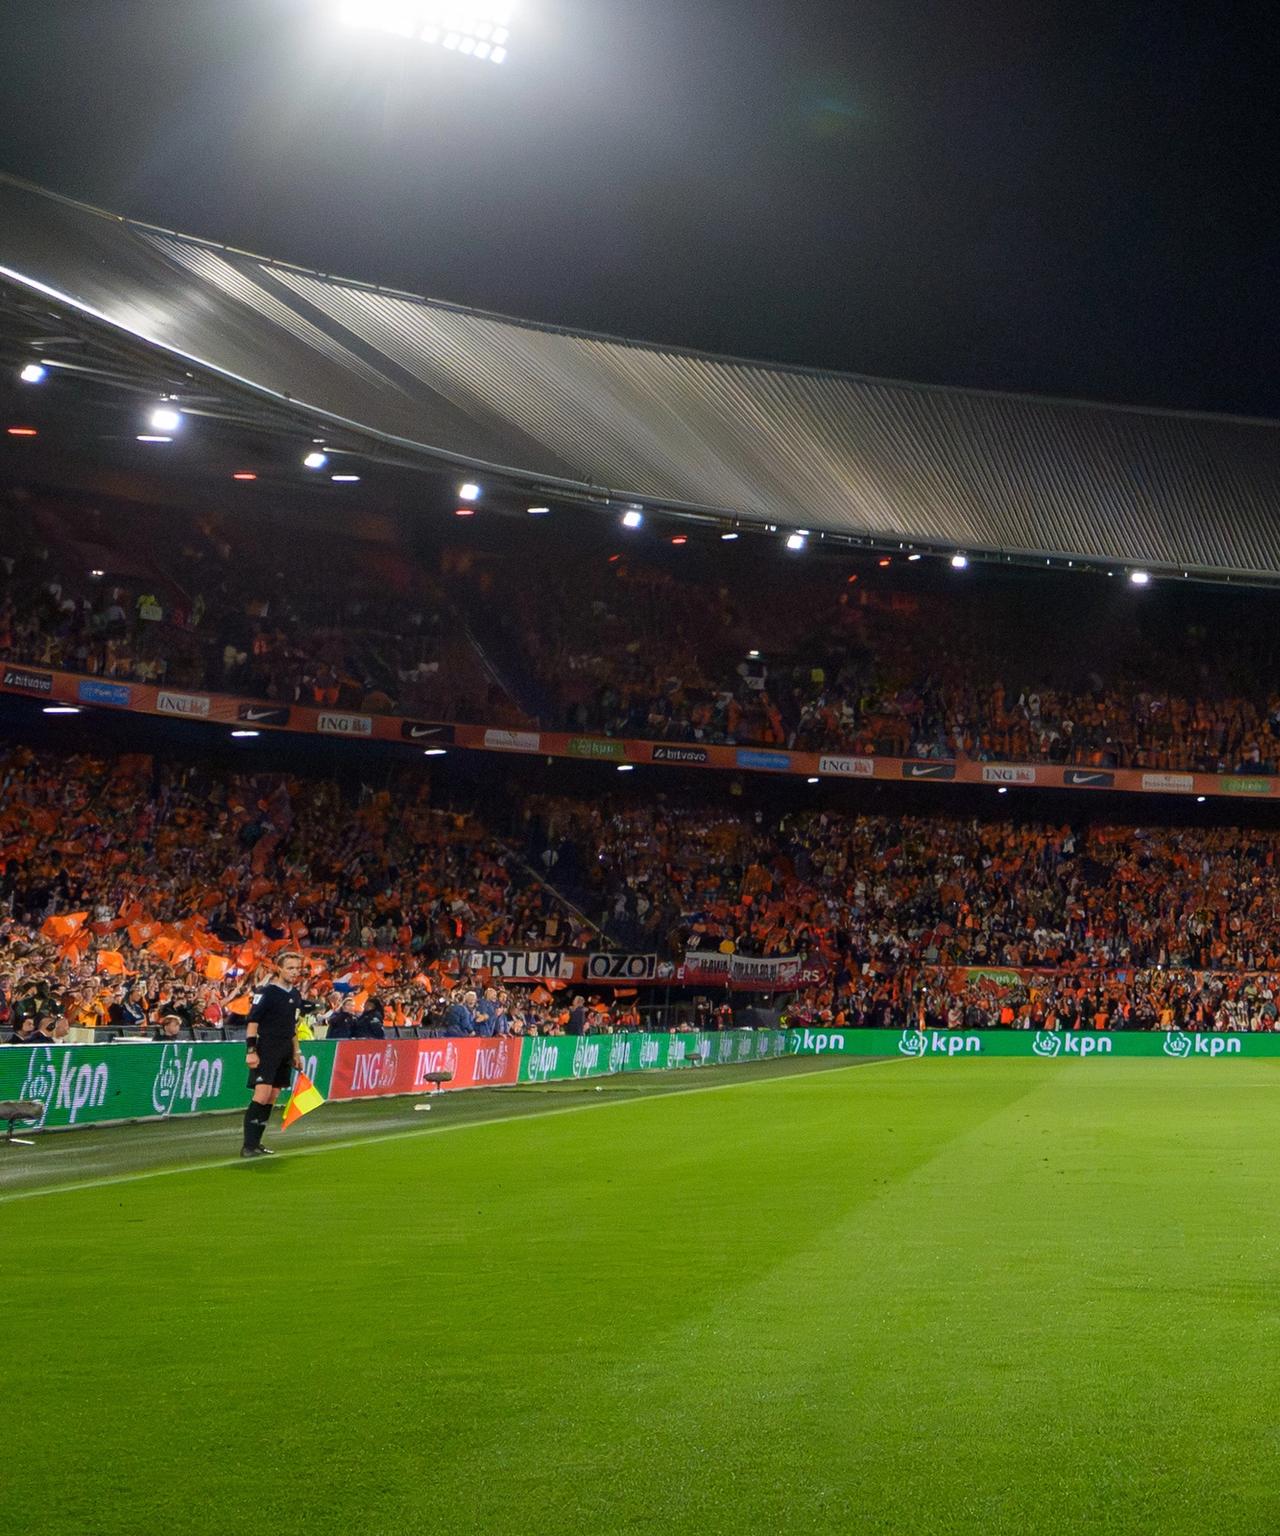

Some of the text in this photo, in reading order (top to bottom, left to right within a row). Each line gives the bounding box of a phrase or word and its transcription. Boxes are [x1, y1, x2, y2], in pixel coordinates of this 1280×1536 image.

[321, 716, 349, 731] ING
[821, 754, 850, 772] ING
[985, 768, 1013, 781] ING
[804, 1030, 844, 1053] kpn
[932, 1032, 980, 1056] kpn
[1065, 1033, 1112, 1056] kpn
[1195, 1033, 1241, 1056] kpn
[351, 1054, 383, 1090] ING
[414, 1051, 443, 1085] ING
[472, 1048, 496, 1080] ING
[55, 1051, 108, 1123] kpn
[180, 1047, 222, 1111] kpn
